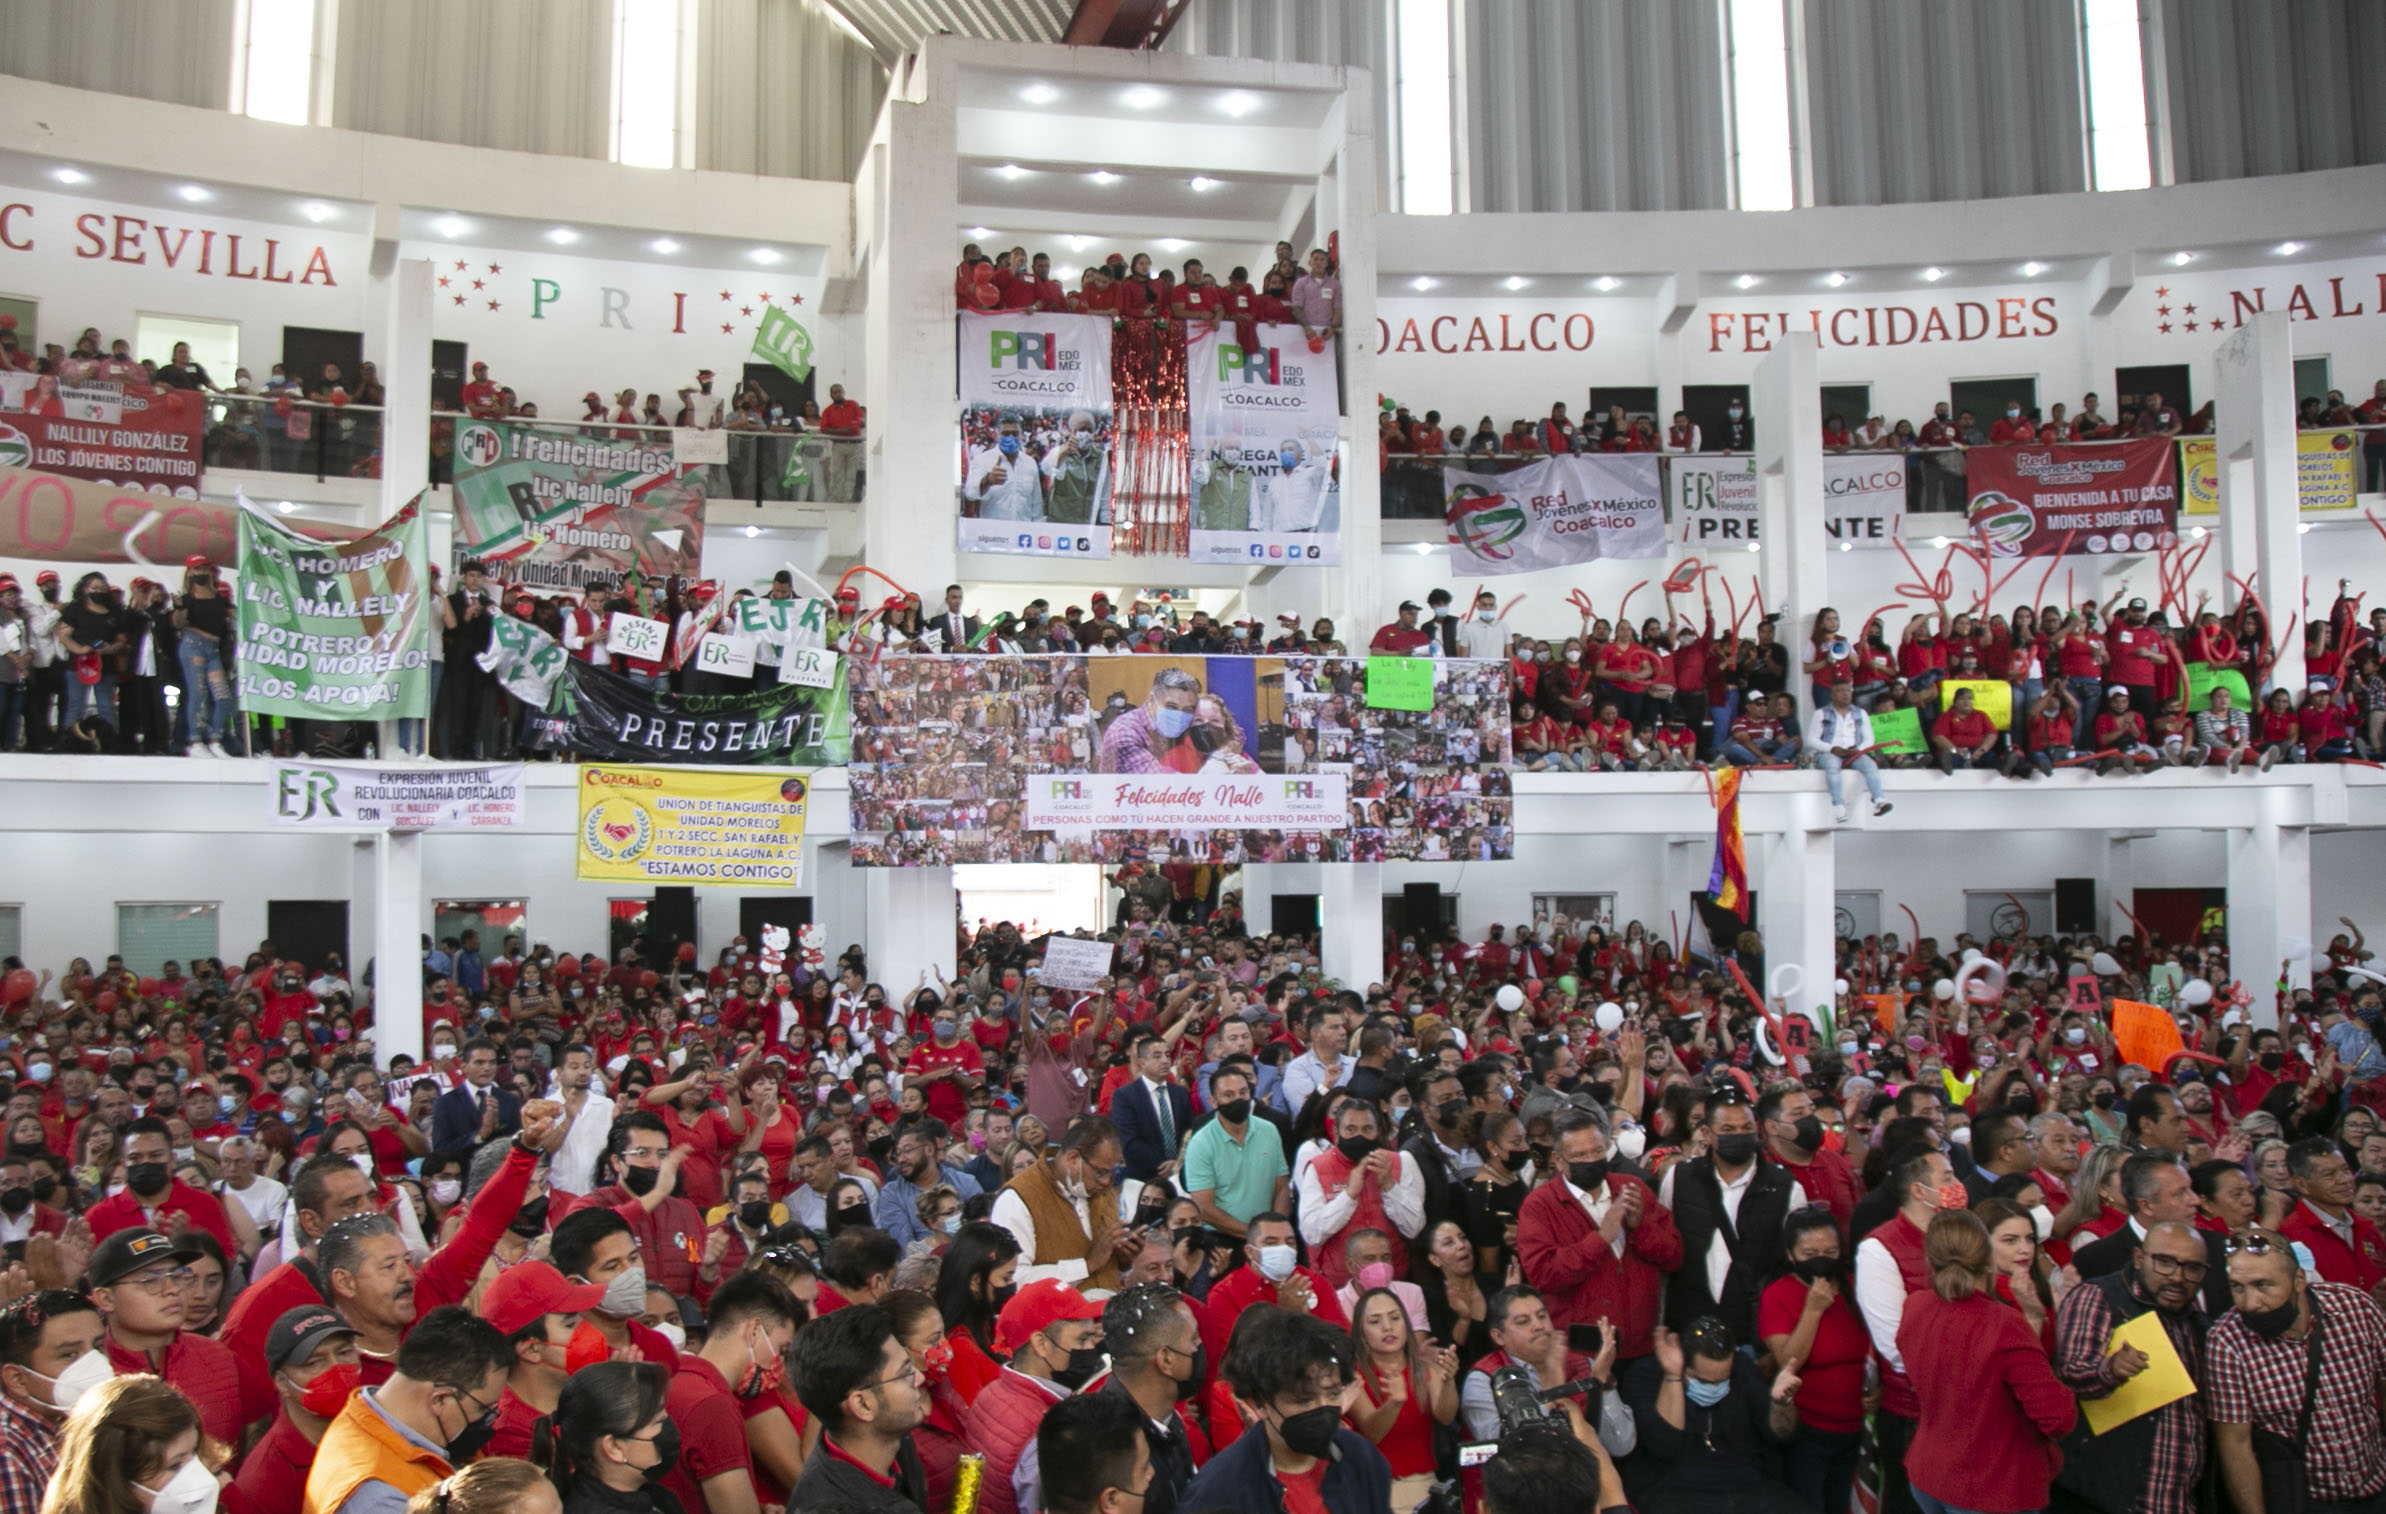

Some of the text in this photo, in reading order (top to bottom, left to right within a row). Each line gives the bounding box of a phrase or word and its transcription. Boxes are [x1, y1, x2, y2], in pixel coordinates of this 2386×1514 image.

[76, 213, 337, 287] SEVILLA
[990, 329, 1056, 371] PRI
[1058, 350, 1080, 361] EDO
[1218, 343, 1280, 386] PRI
[1282, 365, 1304, 376] EDO
[997, 379, 1076, 393] COACALCO
[1225, 394, 1301, 408] COACALCO
[48, 423, 110, 446] NALLILY
[112, 431, 190, 453] GONZÁLEZ
[37, 448, 66, 466] LOS
[69, 449, 133, 472] JÓVENES
[2018, 453, 2050, 466] Red
[2339, 451, 2351, 459] DE
[136, 456, 197, 477] CONTIGO
[2040, 473, 2092, 484] Coacalco
[2311, 473, 2341, 482] RAFAEL
[533, 476, 632, 507] Lic Nallely
[1531, 490, 1568, 512] Red
[1720, 485, 1756, 499] Juvenil
[2034, 484, 2174, 508] BIENVENIDA A TU CASA
[1552, 514, 1636, 535] Coacalco
[2047, 508, 2165, 530] MONSE SOBREYRA
[522, 520, 631, 550] Lic Homero
[298, 541, 404, 575] HOMERO
[521, 560, 569, 584] Unidad
[571, 563, 624, 593] Morelos
[316, 580, 337, 597] Y
[295, 592, 410, 618] NALLELY
[252, 622, 397, 655] POTRERO Y
[618, 618, 659, 647] PRESENTE
[303, 682, 402, 708] APOYA!
[618, 711, 835, 752] PRESENTE
[378, 770, 493, 785] EXPRESIÓN JUVENIL
[354, 785, 516, 801] REVOLUCIONARIA COACALCO
[1051, 780, 1081, 800] PRI
[1115, 782, 1206, 808] Felicidades
[1214, 783, 1265, 809] Nalle
[1284, 780, 1314, 799] PRI
[358, 807, 380, 821] CON
[452, 809, 458, 820] Y
[658, 799, 803, 815] UNION DE TIANGUISTAS DE
[471, 815, 513, 826] CARRANZA
[680, 815, 781, 829] UNIDAD MORELOS
[1032, 812, 1342, 825] PERSONAS COMO TÚ HACEN GRANDE A NUESTRO PARTIDO
[668, 830, 675, 840] Y
[678, 830, 685, 841] 2
[724, 832, 747, 843] SAN
[750, 833, 791, 845] RAFAEL
[793, 834, 800, 845] Y
[656, 845, 707, 857] POTRERO
[709, 847, 724, 858] LA
[726, 847, 773, 859] LAGUNA
[2076, 982, 2098, 1005] A
